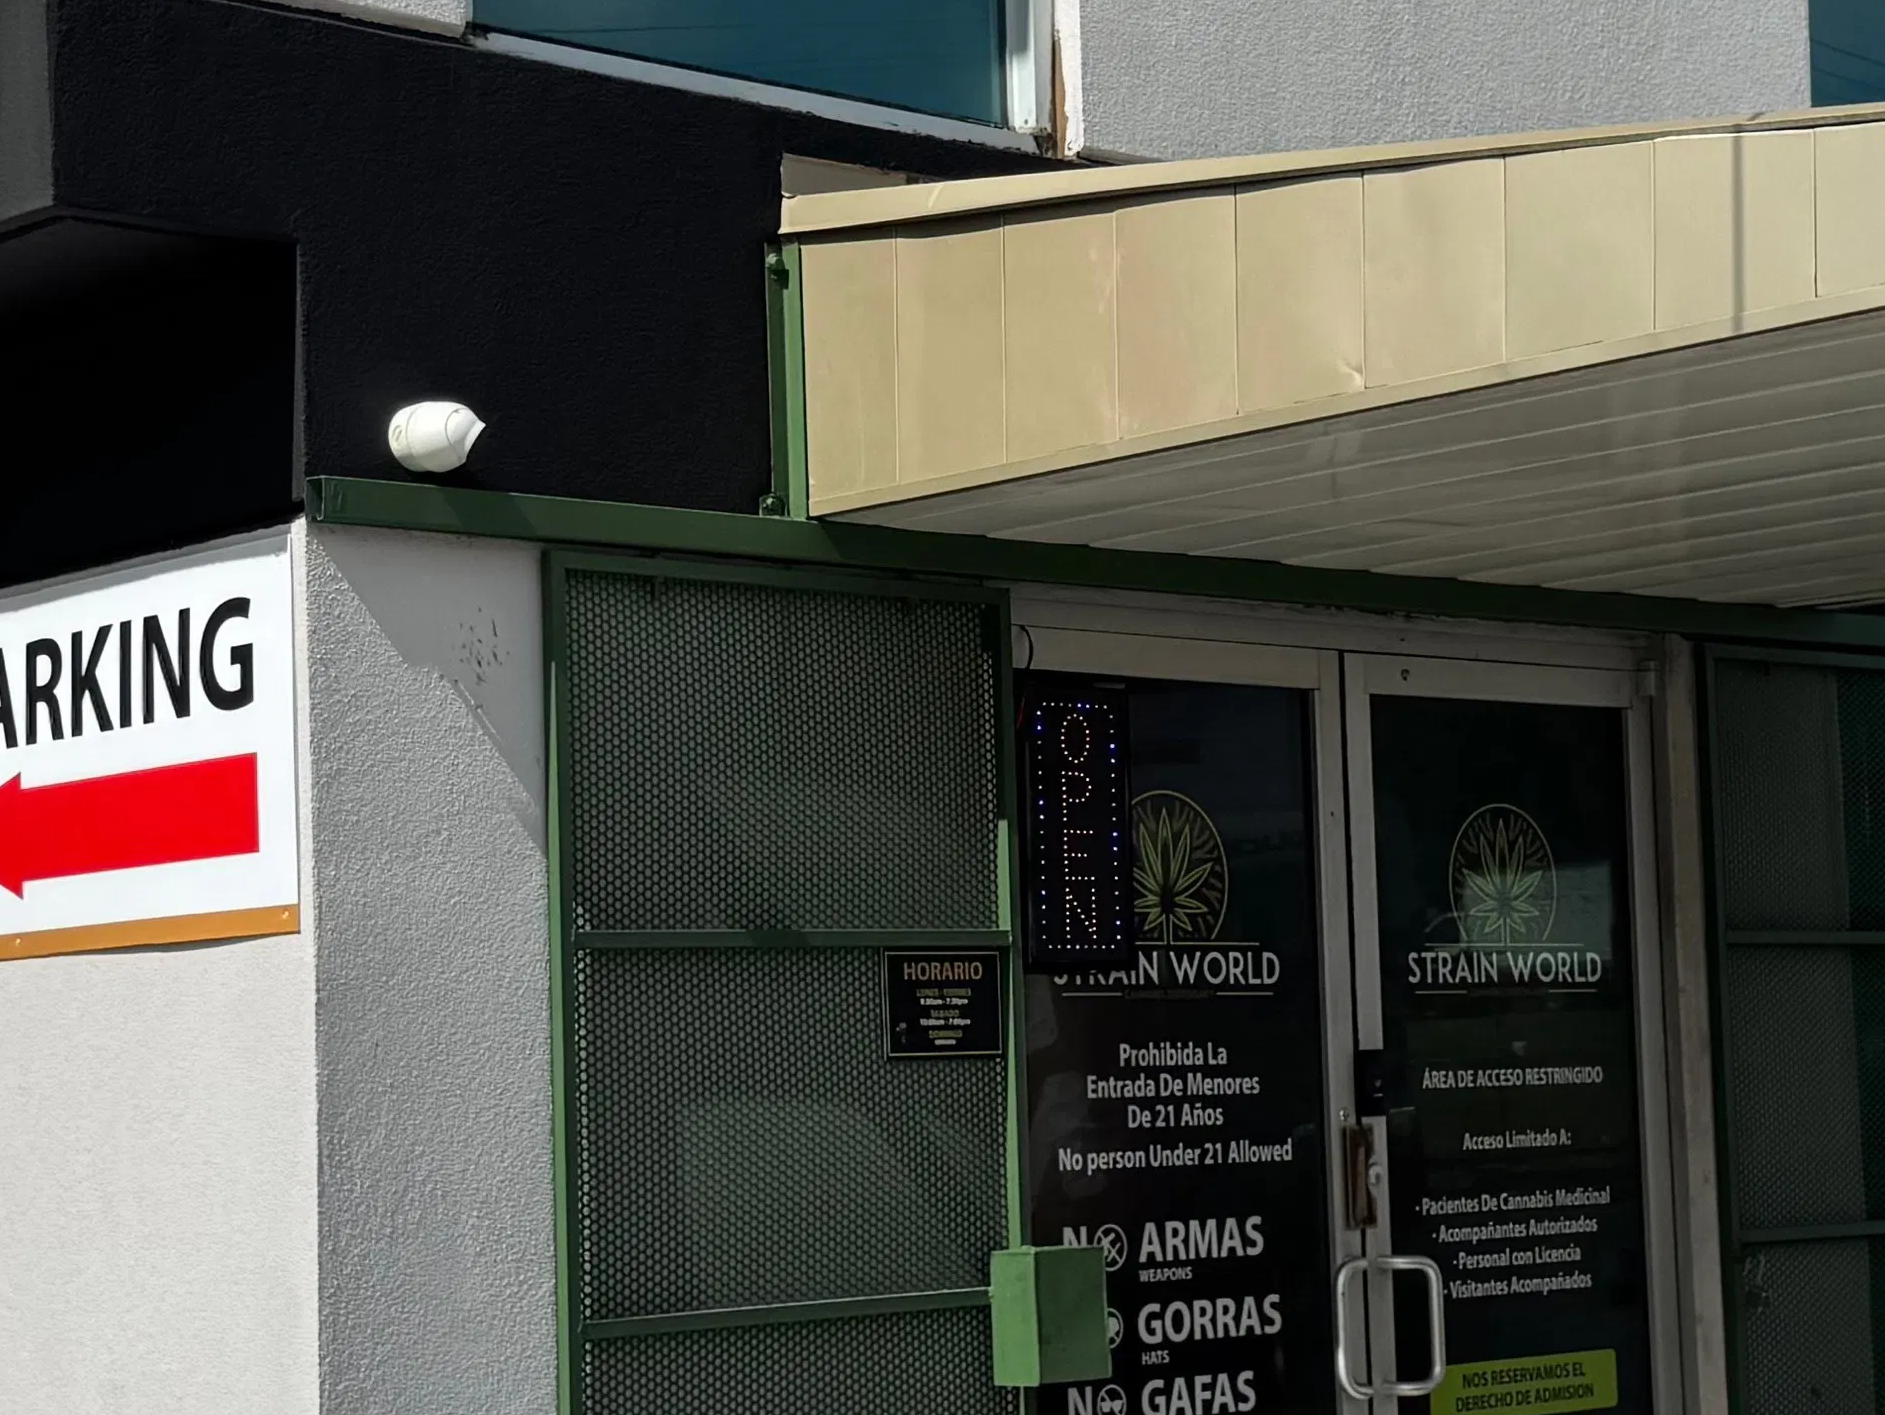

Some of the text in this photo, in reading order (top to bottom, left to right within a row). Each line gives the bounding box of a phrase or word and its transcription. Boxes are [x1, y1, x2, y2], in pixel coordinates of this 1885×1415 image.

[1060, 713, 1097, 940] OPEN
[903, 961, 983, 981] HORARIO
[1169, 950, 1281, 986] WORLD
[1408, 951, 1602, 984] STRAIN WORLD
[1119, 1041, 1228, 1067] Prohibida La
[1086, 1072, 1260, 1099] Entrada De Menores
[1422, 1066, 1604, 1089] ÁREA DE ACCESO RESTRINGIDO
[1127, 1102, 1224, 1129] De 21 Años
[1463, 1129, 1572, 1150] Acceso Limitado A:
[1058, 1138, 1293, 1176] No person Under 21 Allowed
[1422, 1186, 1610, 1215] Pacientes De Cannabis Medicinal
[1138, 1215, 1265, 1263] ARMAS
[1439, 1216, 1598, 1244] Acompañantes Autorizados
[1458, 1243, 1581, 1269] Personal con Licencia
[1139, 1266, 1192, 1283] WEAPONS
[1449, 1271, 1592, 1299] Visitantes Acompañados
[1137, 1293, 1283, 1345] GORRAS
[1141, 1350, 1170, 1366] HATS
[1462, 1362, 1586, 1390] NOS RESERVAMOS EL
[1455, 1391, 1513, 1413] DERECHO
[1515, 1390, 1532, 1406] DE
